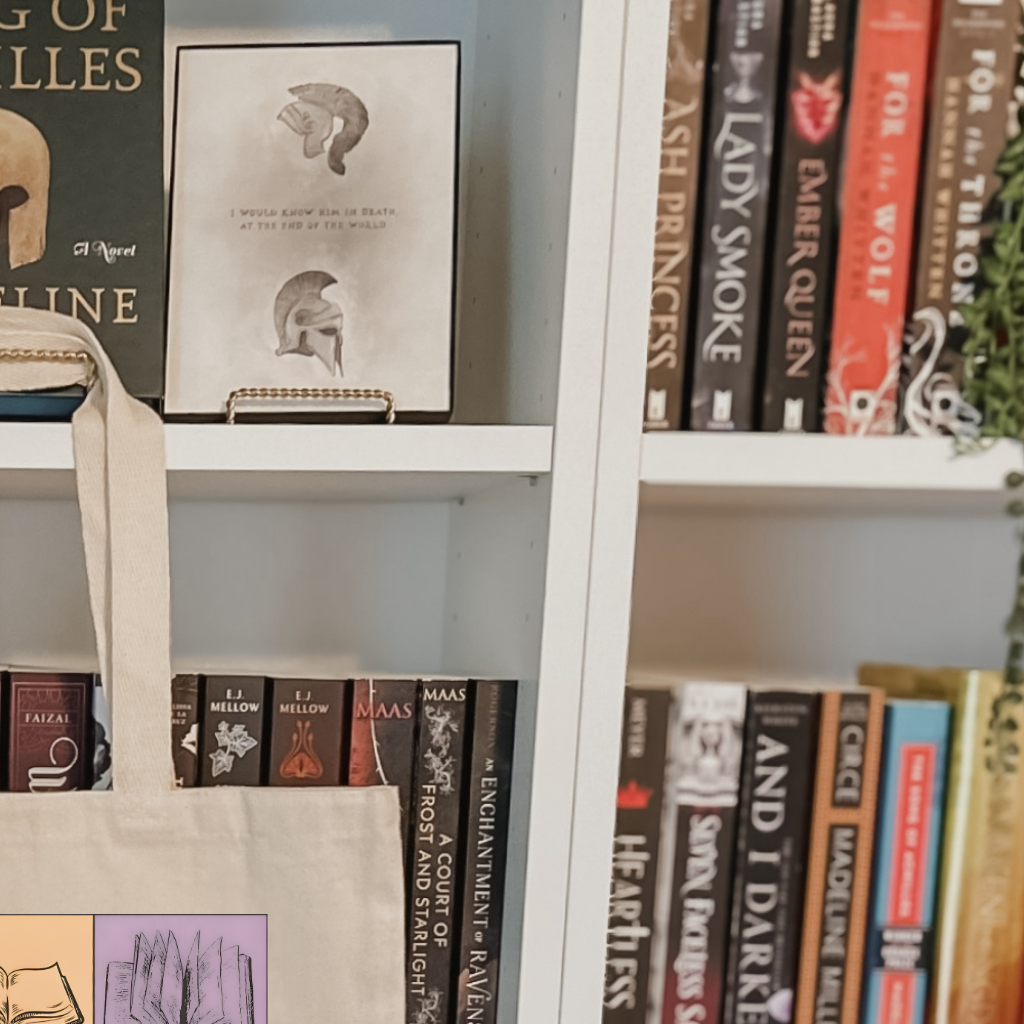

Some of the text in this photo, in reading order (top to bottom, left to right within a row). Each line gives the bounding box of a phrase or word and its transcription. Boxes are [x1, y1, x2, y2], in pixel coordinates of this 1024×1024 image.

[52, 0, 126, 31] OF
[880, 71, 910, 139] FOR
[967, 50, 996, 115] FOR
[937, 76, 961, 179] HANNAH
[714, 112, 764, 219] LADY
[239, 208, 277, 217] WOULD
[281, 208, 314, 217] KNOW
[239, 222, 253, 230] AT
[281, 222, 303, 230] END
[348, 221, 386, 230] WORLD
[647, 98, 697, 370] ASH PRINCESS
[73, 241, 136, 264] A Novel
[784, 158, 829, 378] EMBER QUEEN
[866, 203, 897, 305] WOLF
[703, 224, 751, 364] SMOKE
[25, 712, 70, 723] FAIZAL
[210, 702, 260, 713] MELLOW
[226, 689, 244, 700] E.J.
[279, 703, 329, 714] MELLOW
[295, 691, 312, 701] E.J.
[356, 702, 413, 719] MAAS
[423, 688, 466, 701] MAAS
[484, 757, 495, 771] AN
[751, 733, 790, 833] AND
[834, 724, 865, 803] CIRCE
[473, 776, 498, 929] ENCHANTMENT
[748, 851, 781, 863] I
[411, 784, 436, 995] FROST AND STARLIGHT
[433, 834, 453, 948] A COURT OF
[603, 833, 651, 1010] HEARTLESS
[820, 826, 855, 959] MADELINE
